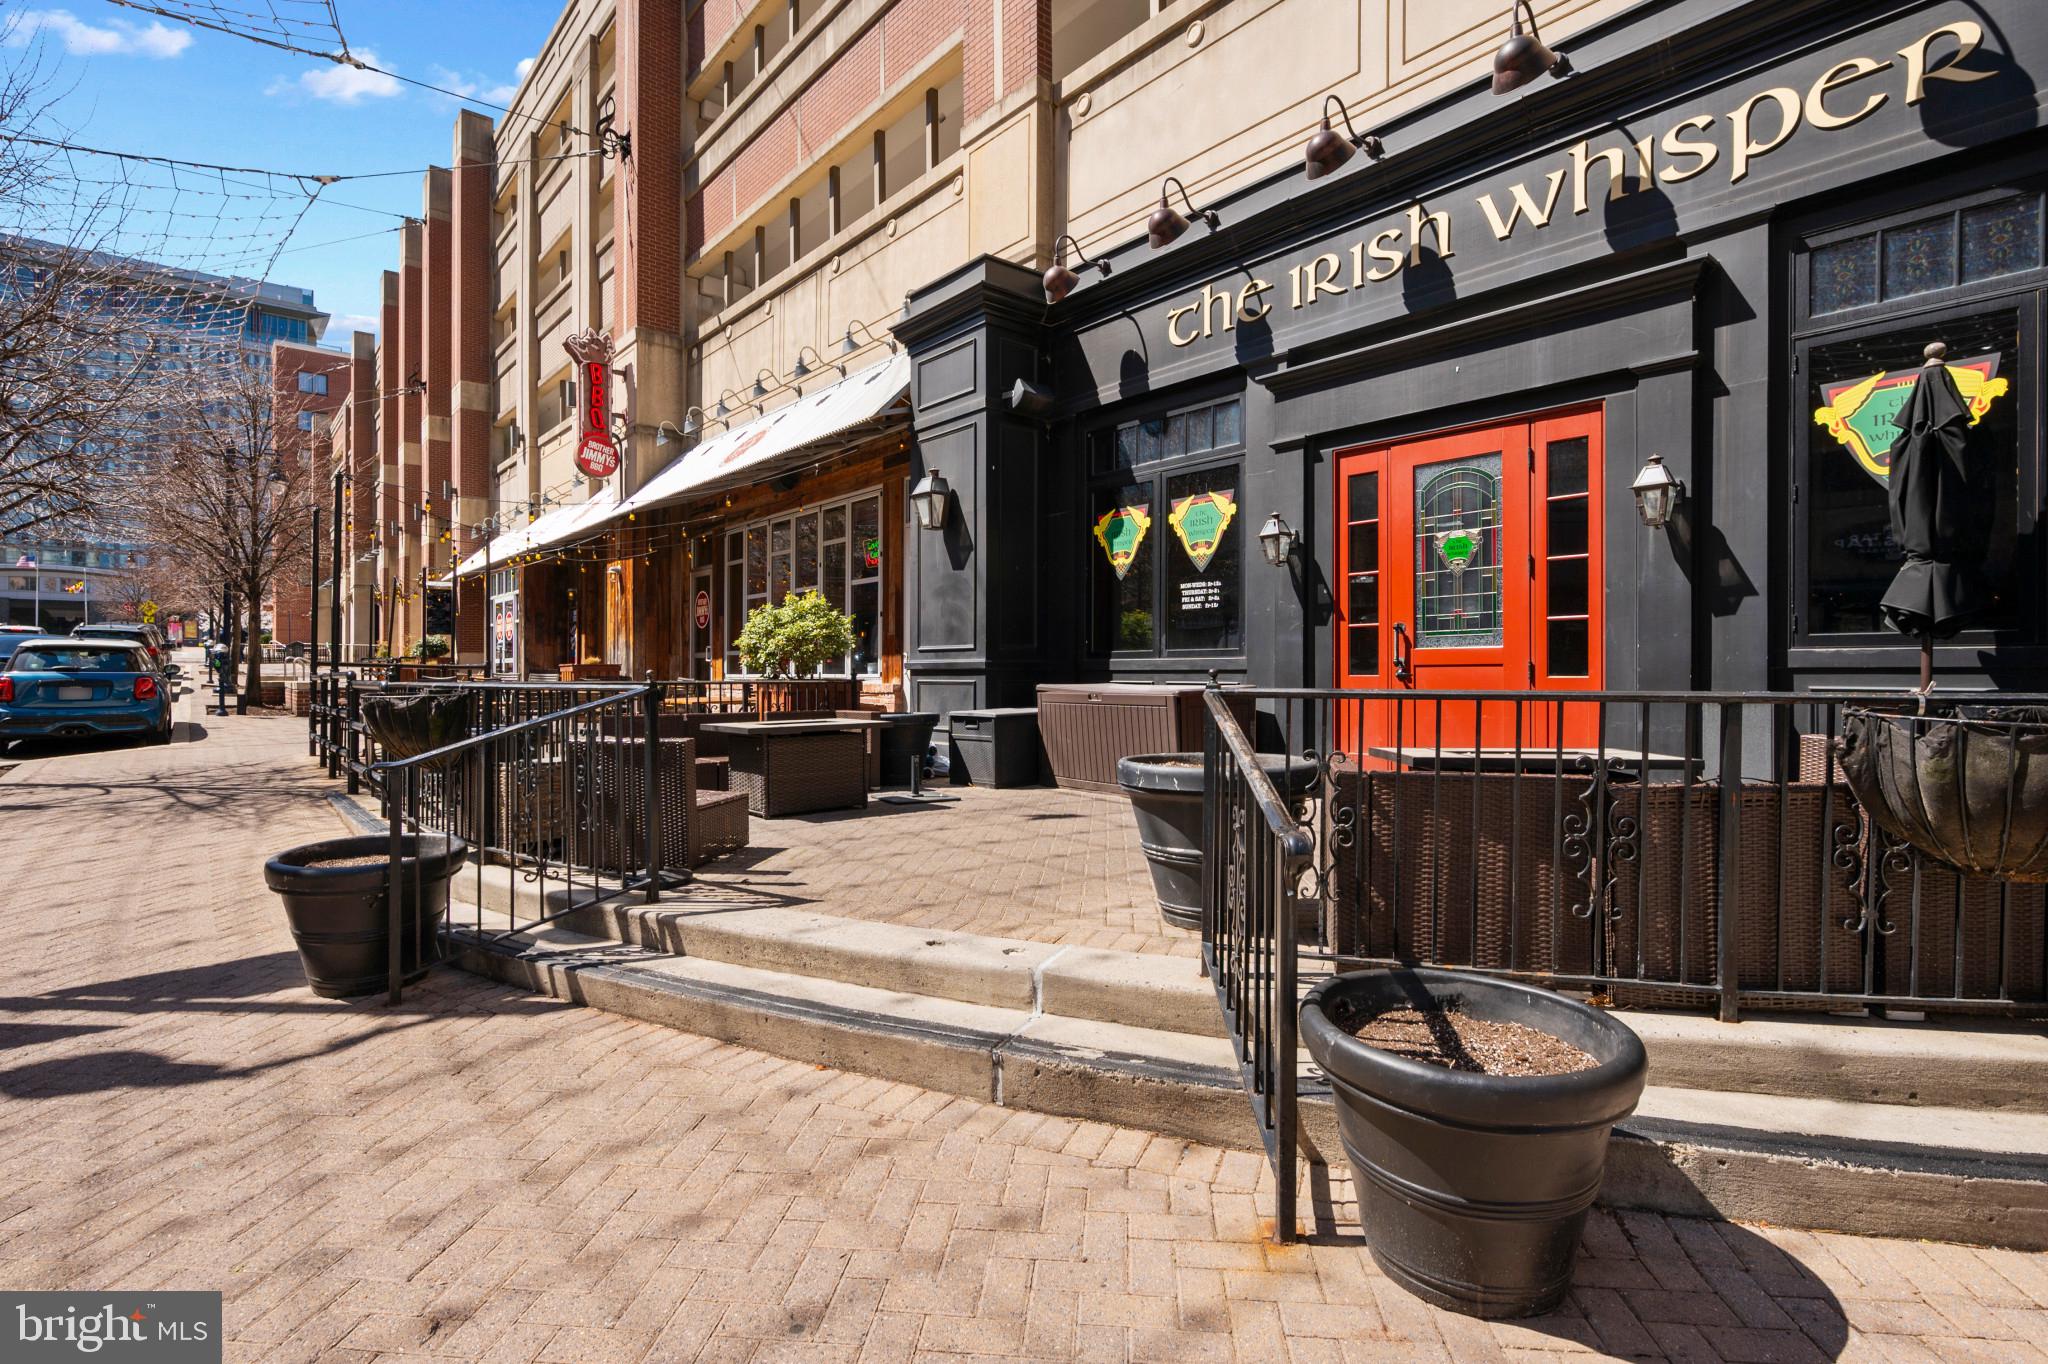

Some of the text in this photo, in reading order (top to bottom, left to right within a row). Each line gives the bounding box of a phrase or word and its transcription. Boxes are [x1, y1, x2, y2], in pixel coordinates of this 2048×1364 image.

[589, 363, 606, 430] BBQ
[587, 440, 615, 456] BROTHER
[590, 461, 603, 472] BBQ
